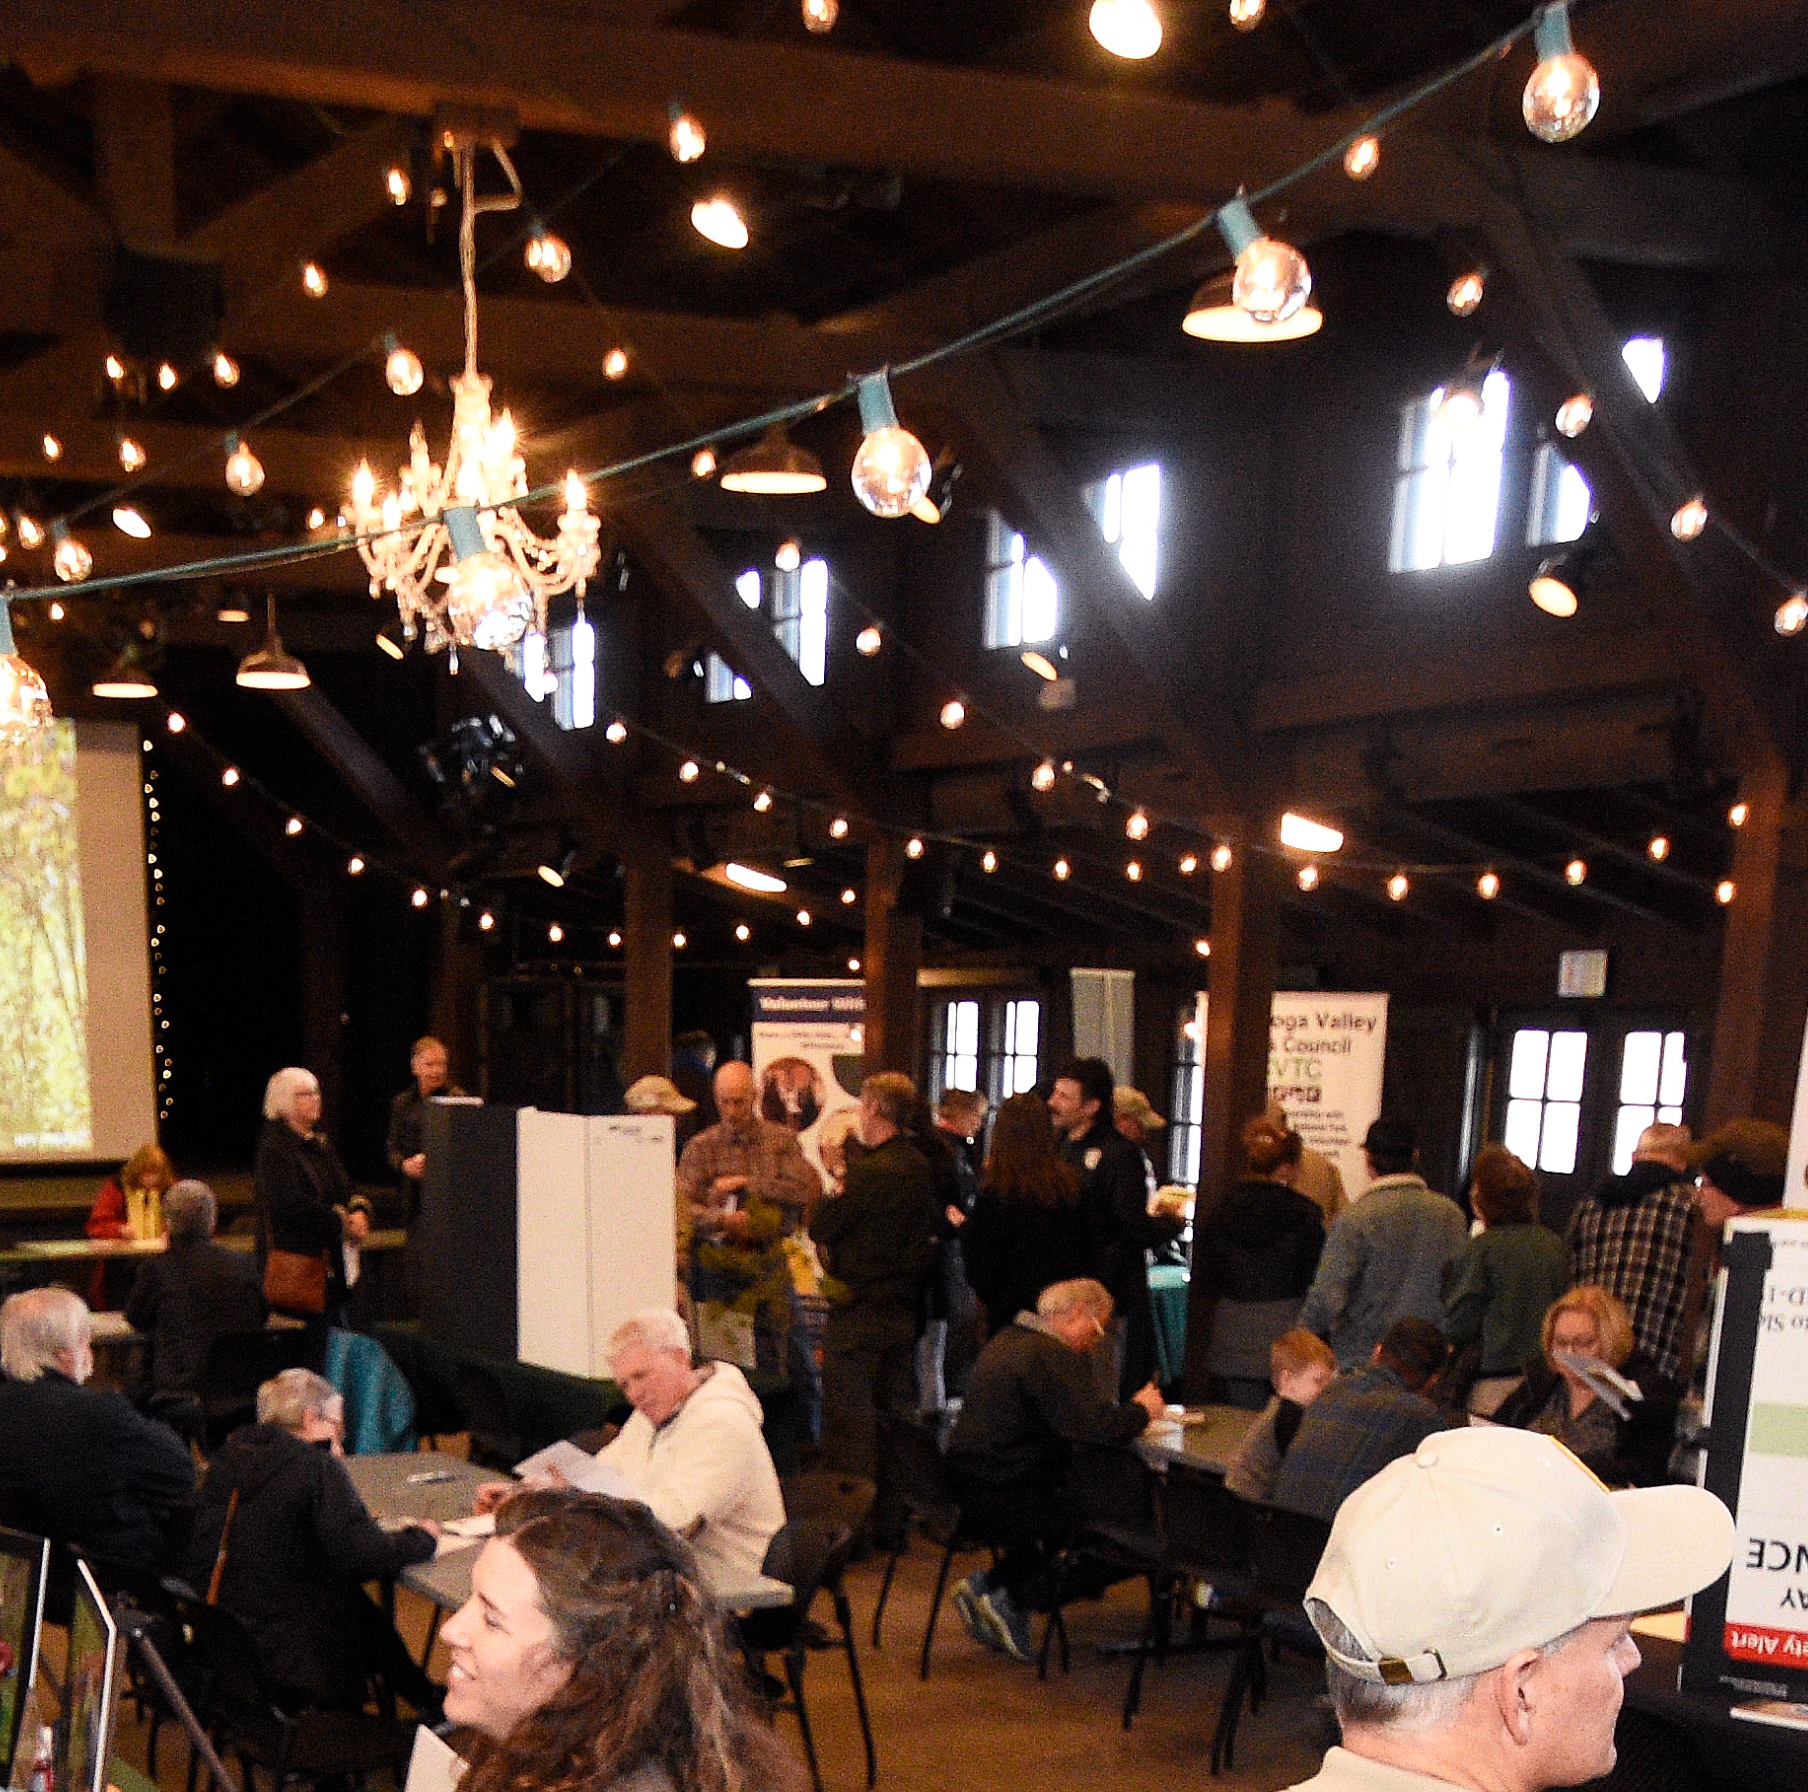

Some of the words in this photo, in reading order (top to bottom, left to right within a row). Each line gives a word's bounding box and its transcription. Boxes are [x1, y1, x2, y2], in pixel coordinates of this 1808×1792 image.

[1316, 1011, 1377, 1034] Valley
[1284, 1037, 1351, 1055] Council
[1732, 1631, 1779, 1656] Alert
